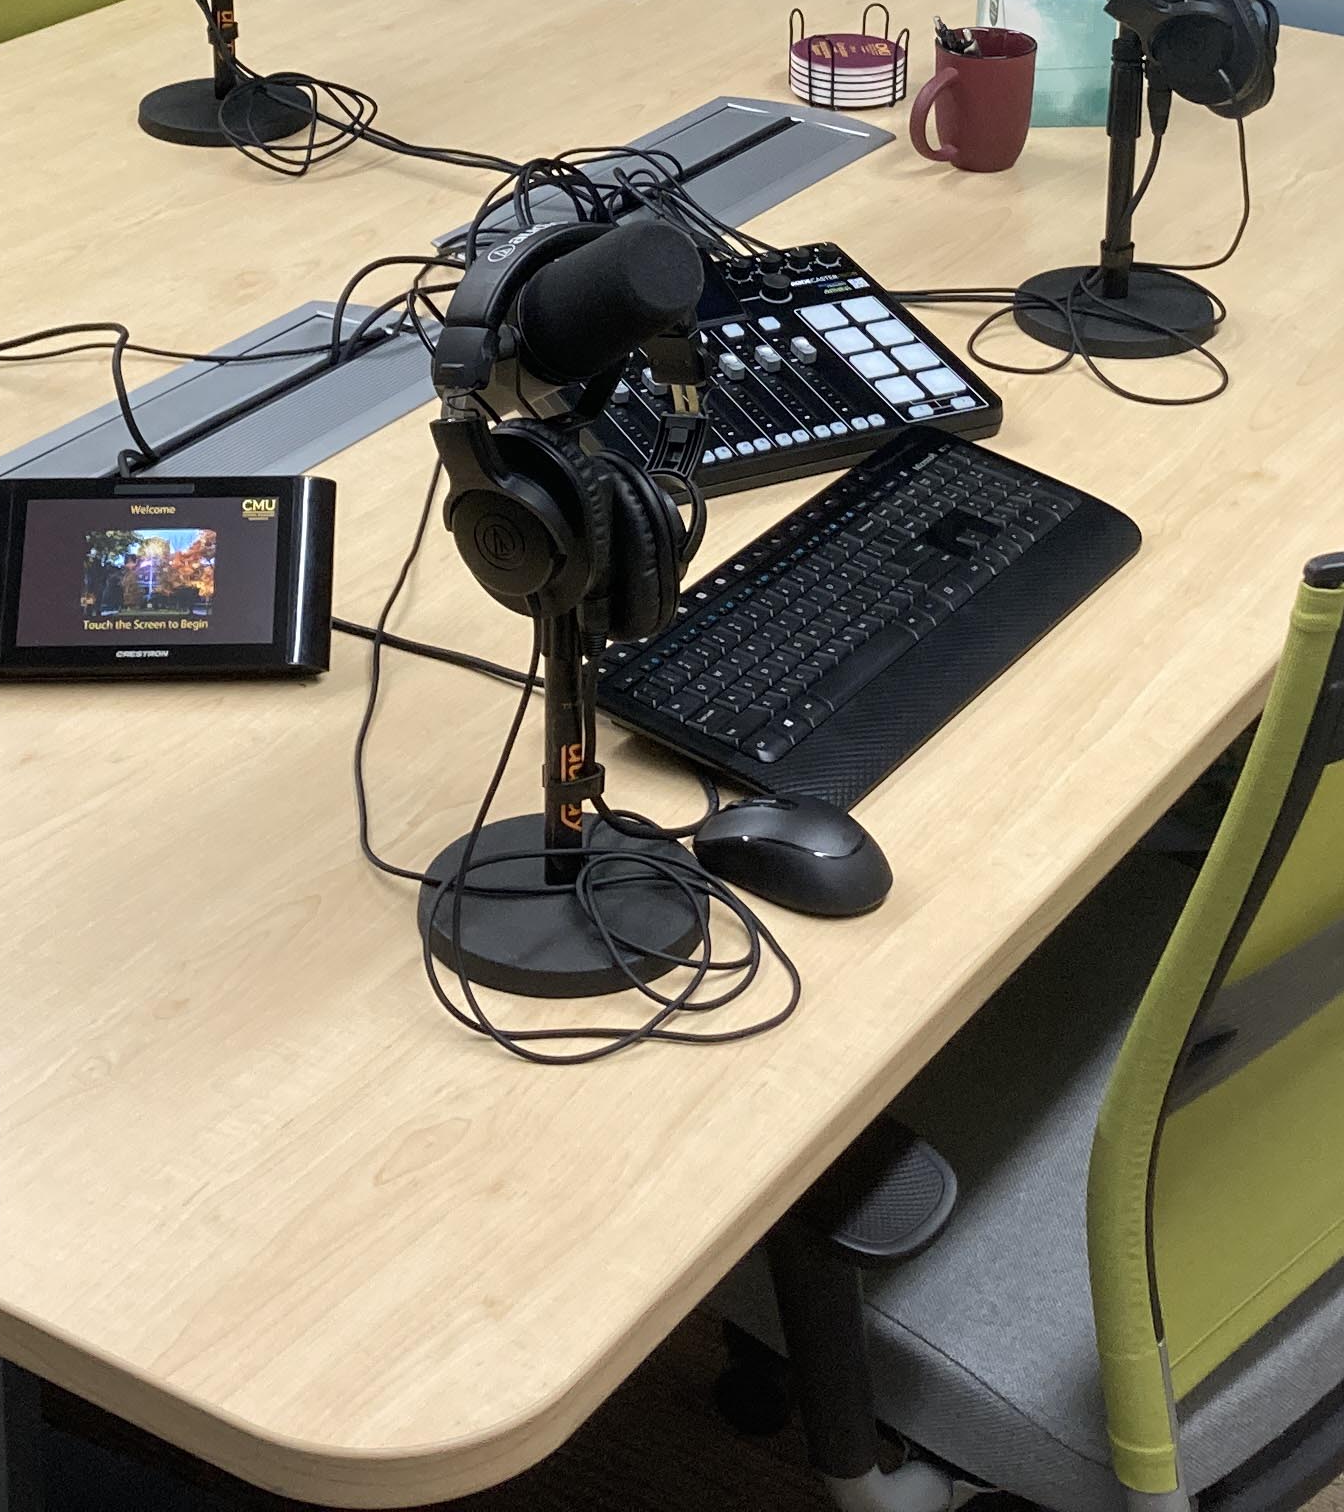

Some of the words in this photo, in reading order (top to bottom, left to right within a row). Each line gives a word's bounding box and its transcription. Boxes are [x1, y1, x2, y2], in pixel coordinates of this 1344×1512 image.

[130, 505, 176, 515] Welcome
[243, 499, 276, 511] CMU
[83, 620, 113, 630] Touch
[116, 620, 131, 630] the
[133, 620, 166, 630] Screen
[169, 620, 178, 629] to
[181, 619, 208, 631] Begin
[116, 650, 169, 658] CRESTRON
